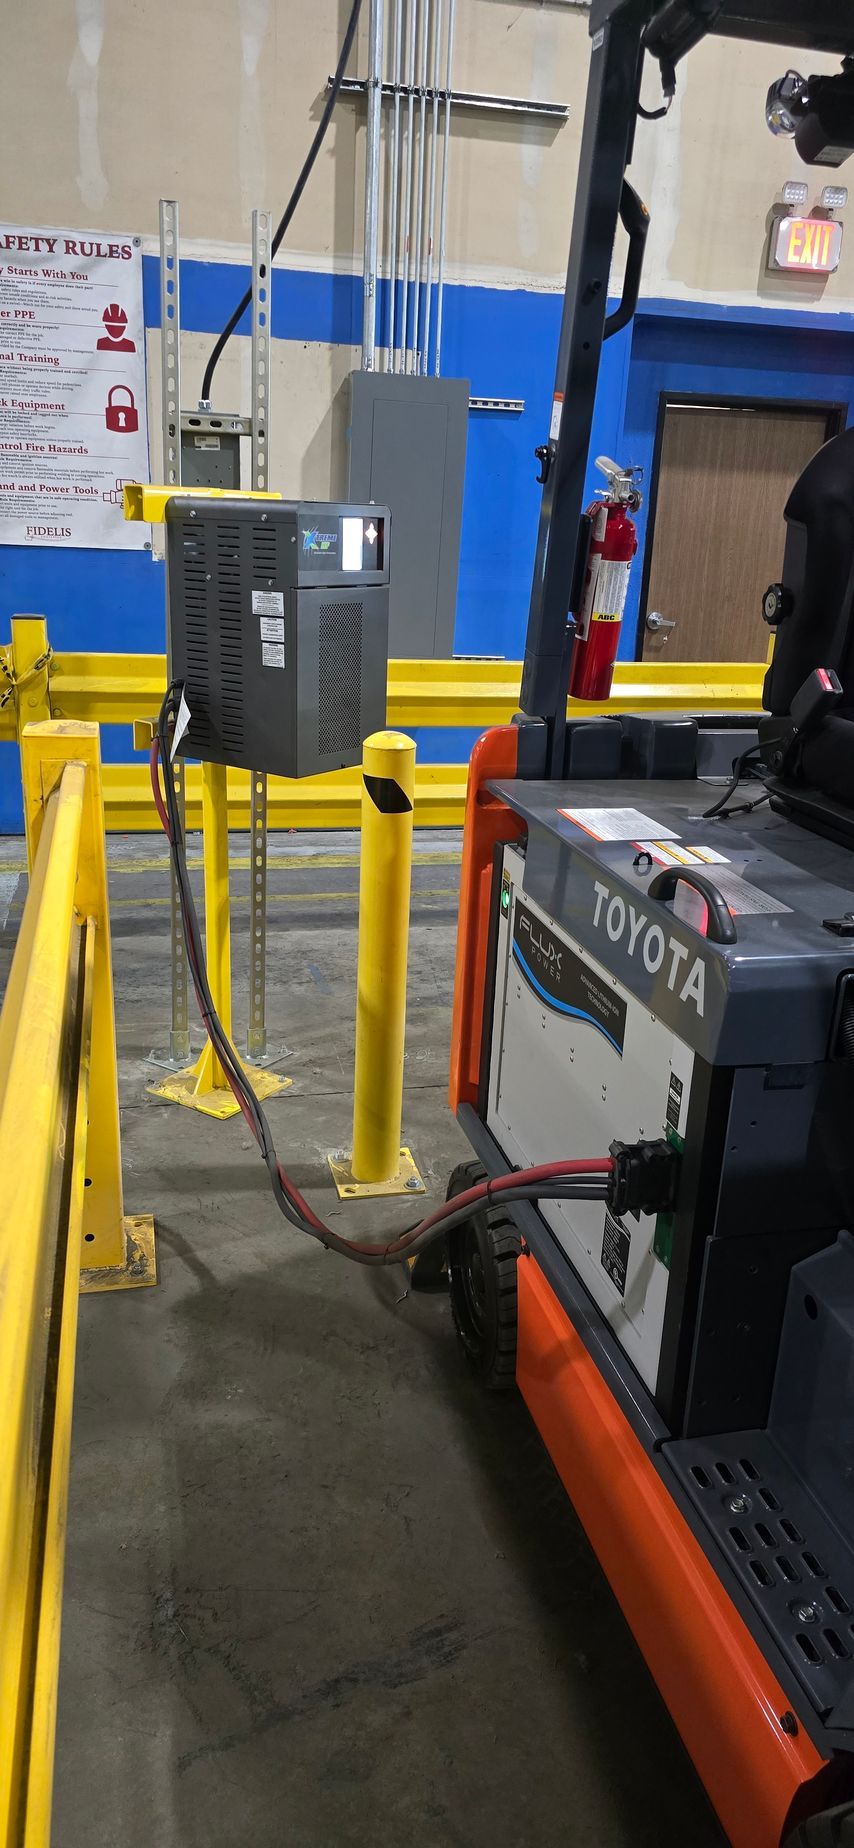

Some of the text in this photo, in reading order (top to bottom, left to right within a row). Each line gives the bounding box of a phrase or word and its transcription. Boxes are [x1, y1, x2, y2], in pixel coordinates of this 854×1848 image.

[63, 239, 132, 261] RULES
[787, 221, 833, 266] EXIT
[7, 265, 39, 277] Starts
[42, 268, 67, 280] With
[69, 271, 89, 281] You
[14, 309, 35, 320] PPE
[17, 352, 60, 366] Training
[0, 398, 65, 411] k Equipment
[25, 443, 45, 452] Fire
[48, 444, 89, 455] Hazards
[18, 484, 36, 492] and
[39, 484, 70, 494] Power
[73, 486, 99, 495] Tools
[26, 526, 72, 537] FIDELIS
[519, 914, 563, 970] FLUX
[592, 881, 707, 1017] TOYOTA
[531, 948, 562, 983] POWER
[587, 991, 610, 1017] TECHNOLOGY
